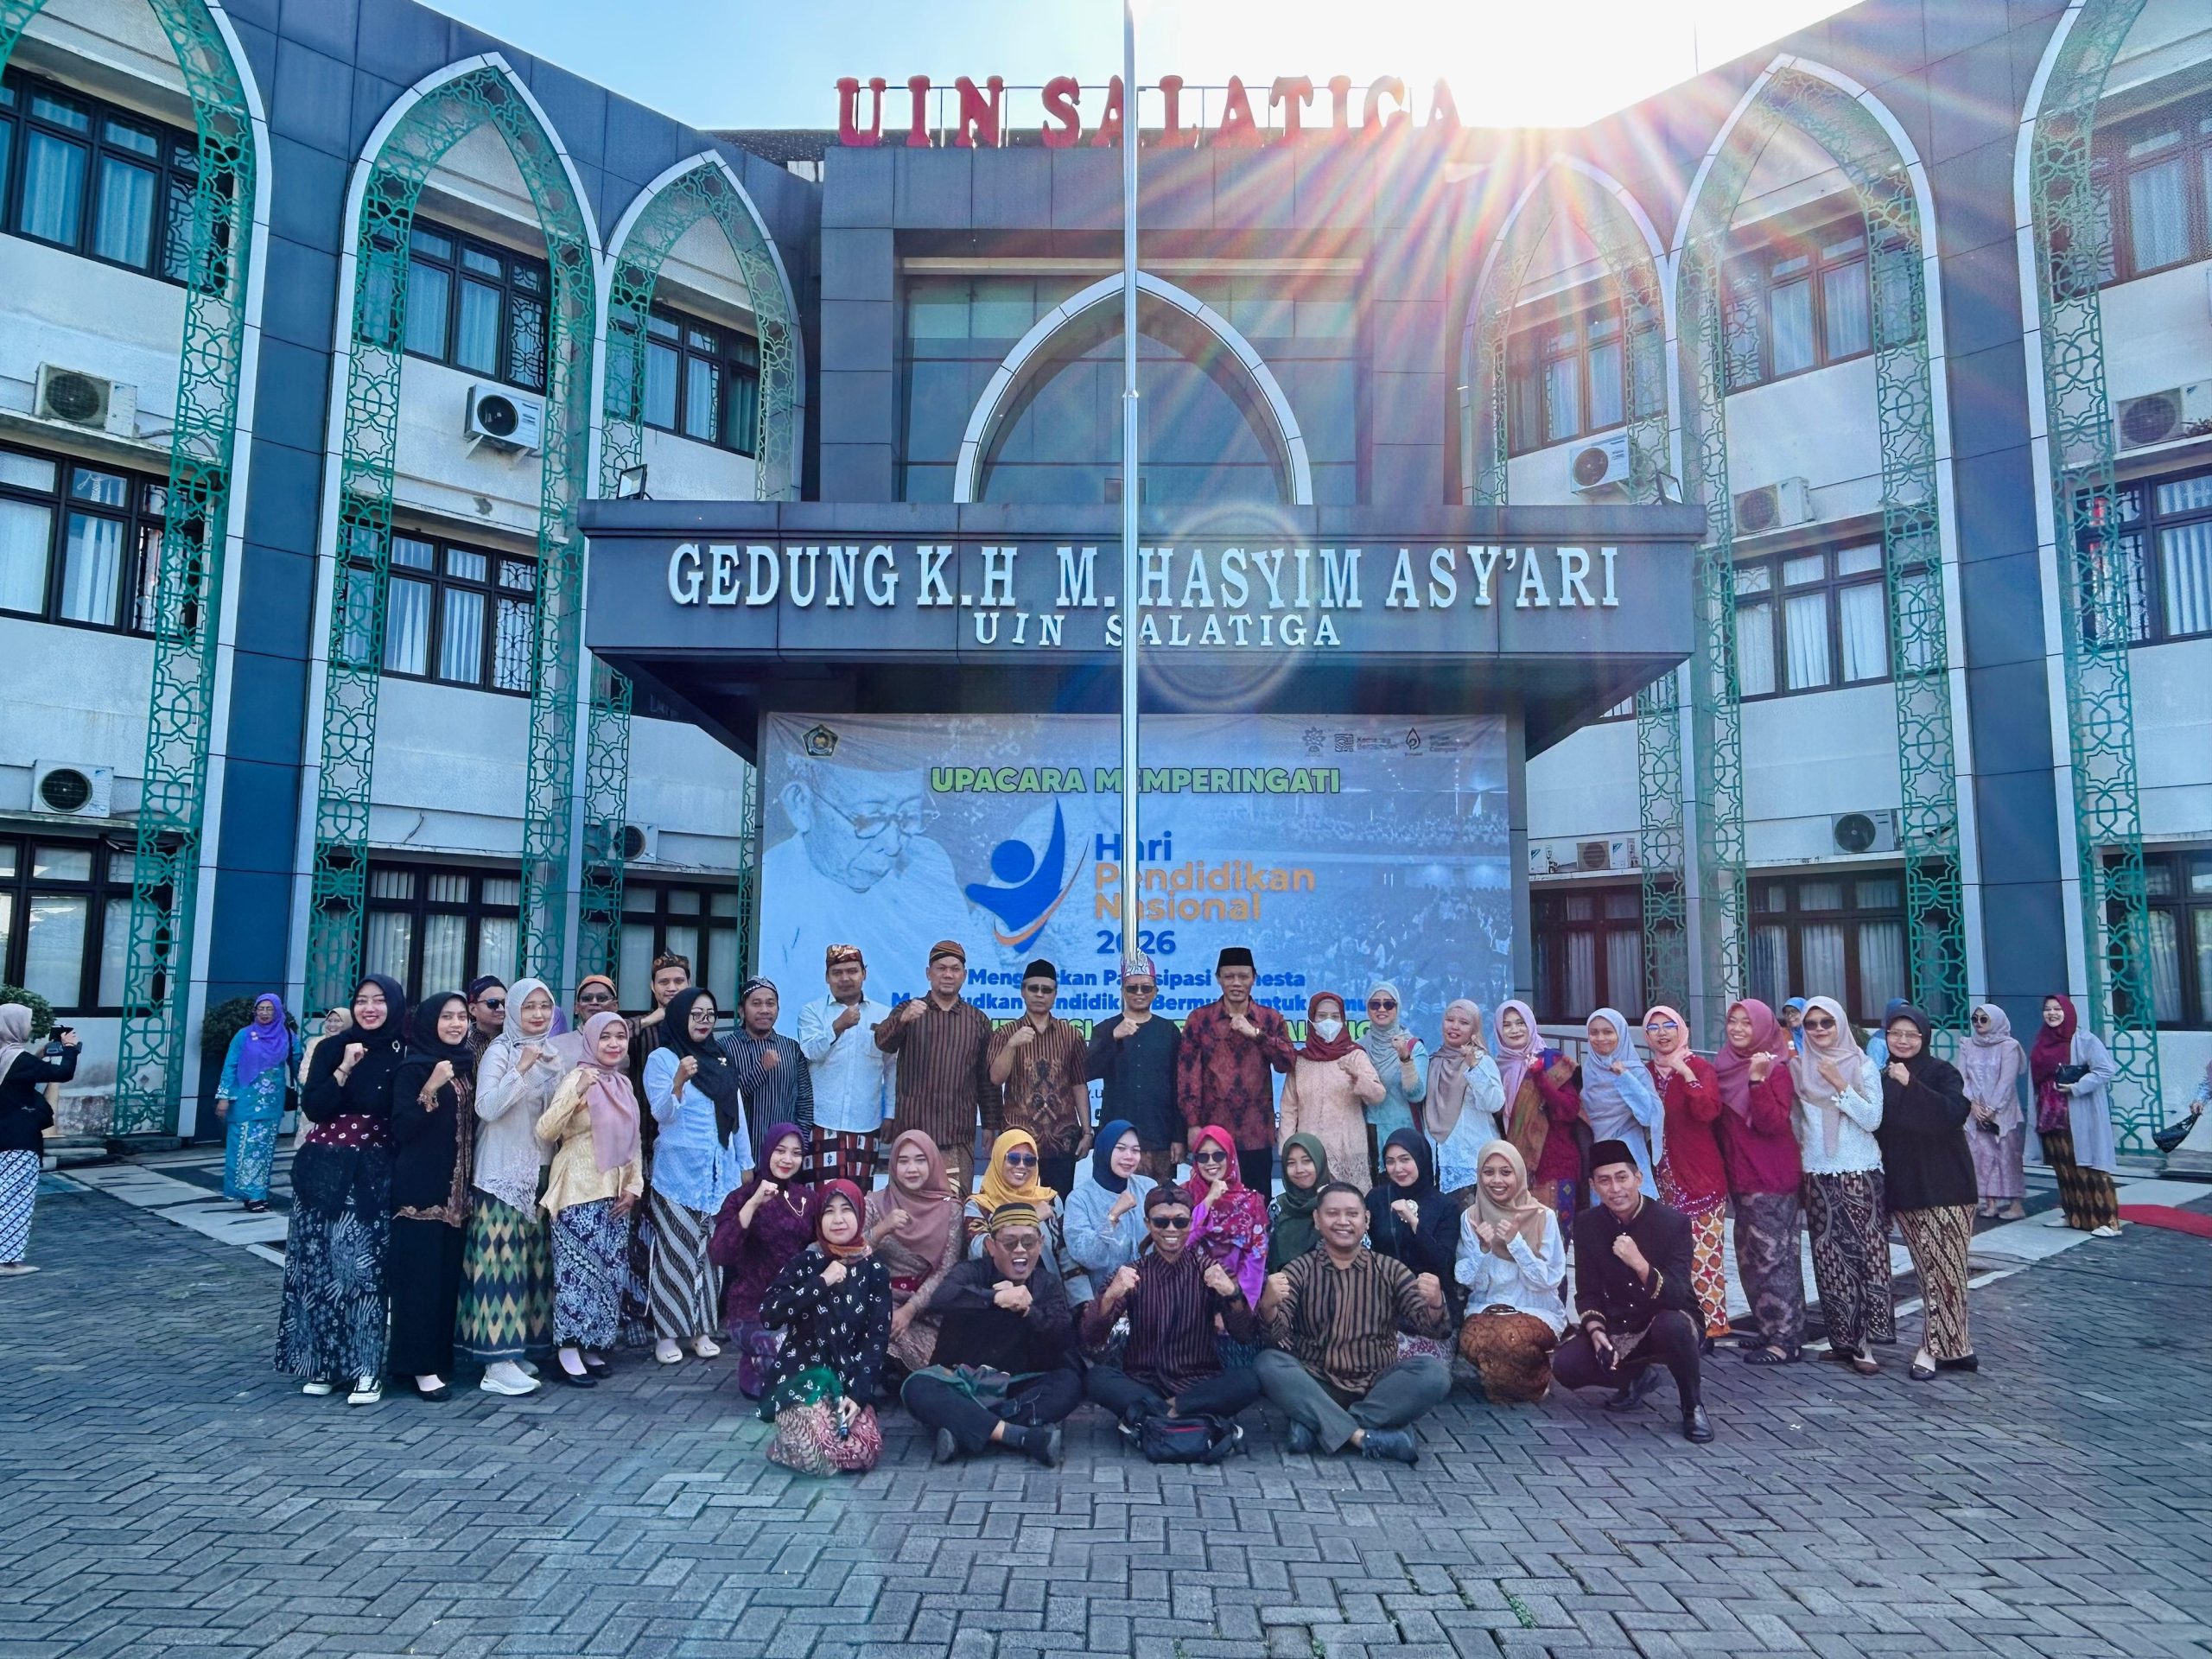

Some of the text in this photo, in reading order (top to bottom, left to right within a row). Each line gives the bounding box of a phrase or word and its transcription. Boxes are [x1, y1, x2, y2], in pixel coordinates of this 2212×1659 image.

[836, 74, 1464, 149] UIN SALATIGA
[668, 543, 900, 607] GEDUNG
[916, 545, 1018, 607] K.H
[1385, 545, 1619, 607] ASY'ARI
[974, 612, 1341, 646] UIN SALATIGA
[931, 767, 1340, 793] UPACARA MMPERINGATI
[1096, 830, 1172, 861] Hri
[1095, 859, 1315, 891] Pndidikan
[1095, 891, 1261, 920] Nsional
